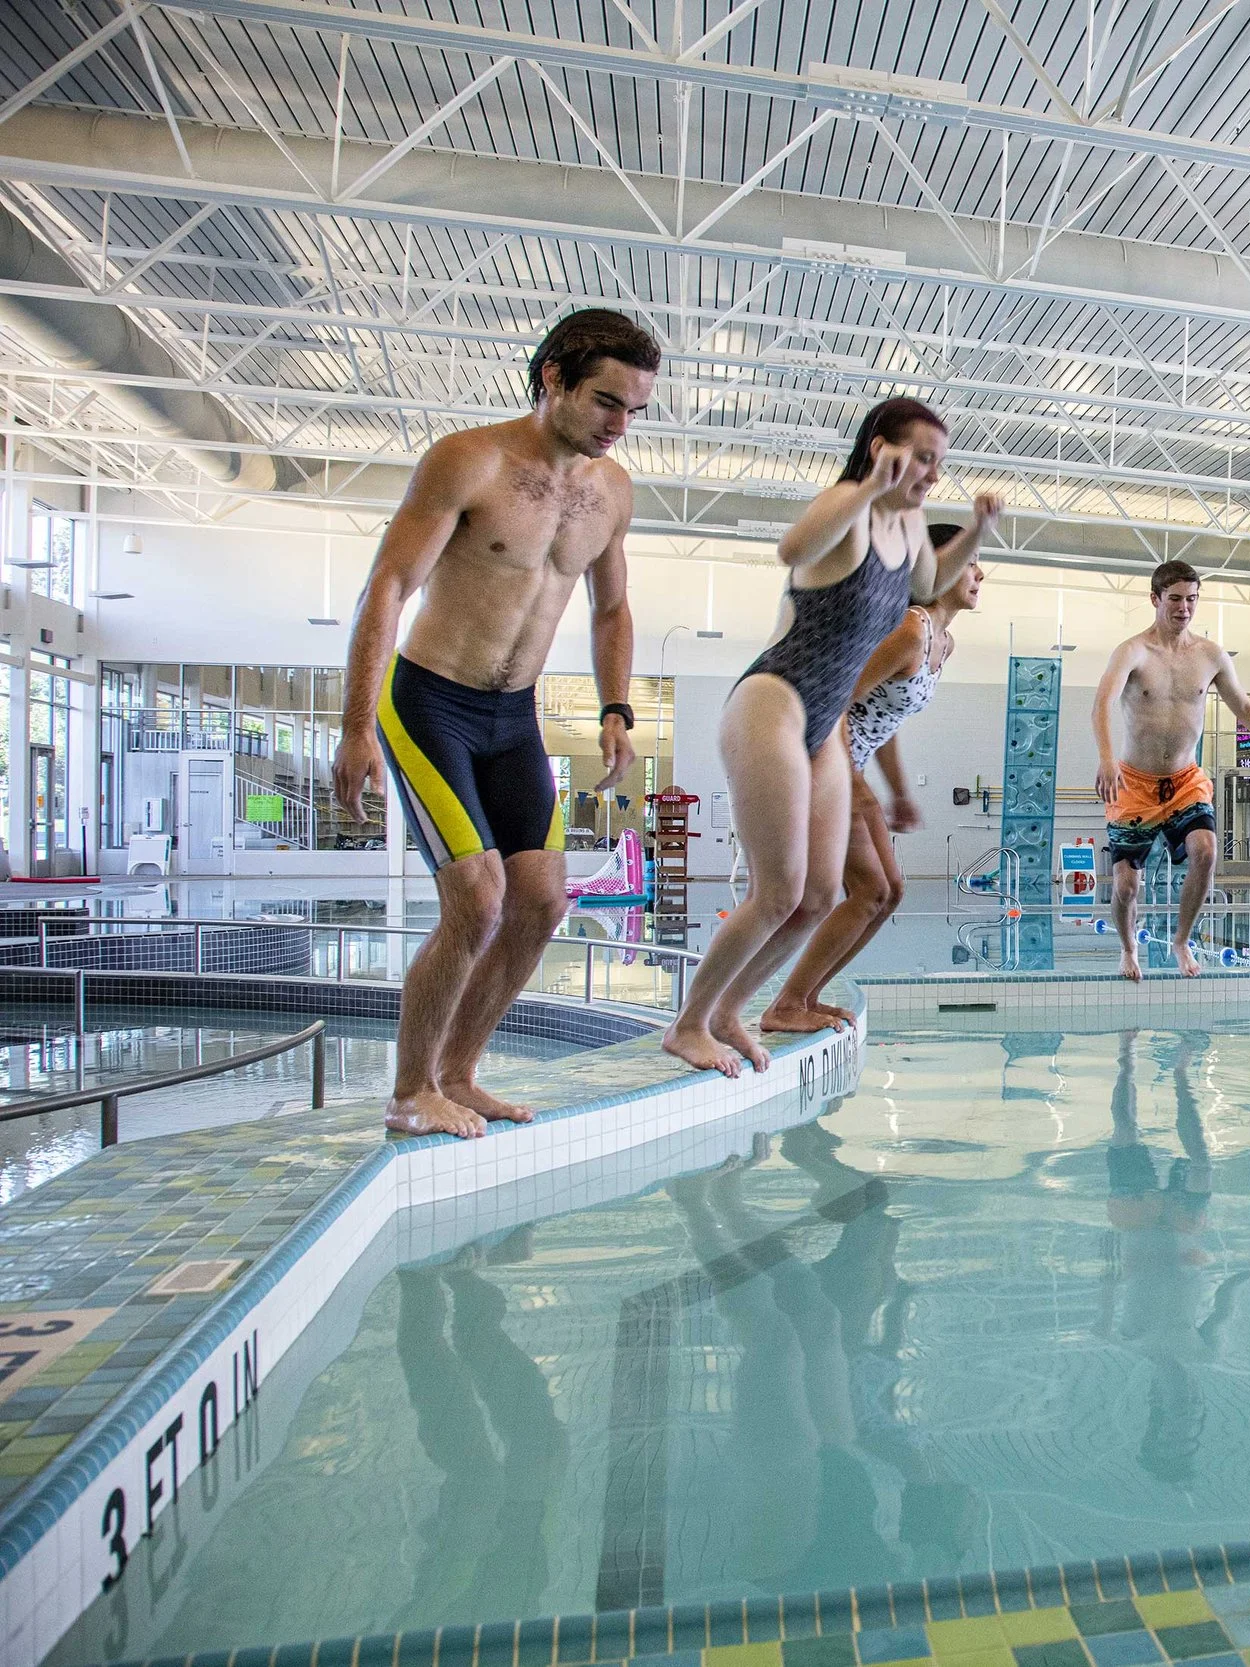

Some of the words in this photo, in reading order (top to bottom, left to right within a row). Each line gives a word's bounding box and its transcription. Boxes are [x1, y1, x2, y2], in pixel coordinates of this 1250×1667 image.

[800, 1054, 815, 1087] NO
[101, 1487, 129, 1593] 3
[143, 1411, 184, 1539] FT
[232, 1328, 259, 1421] IN
